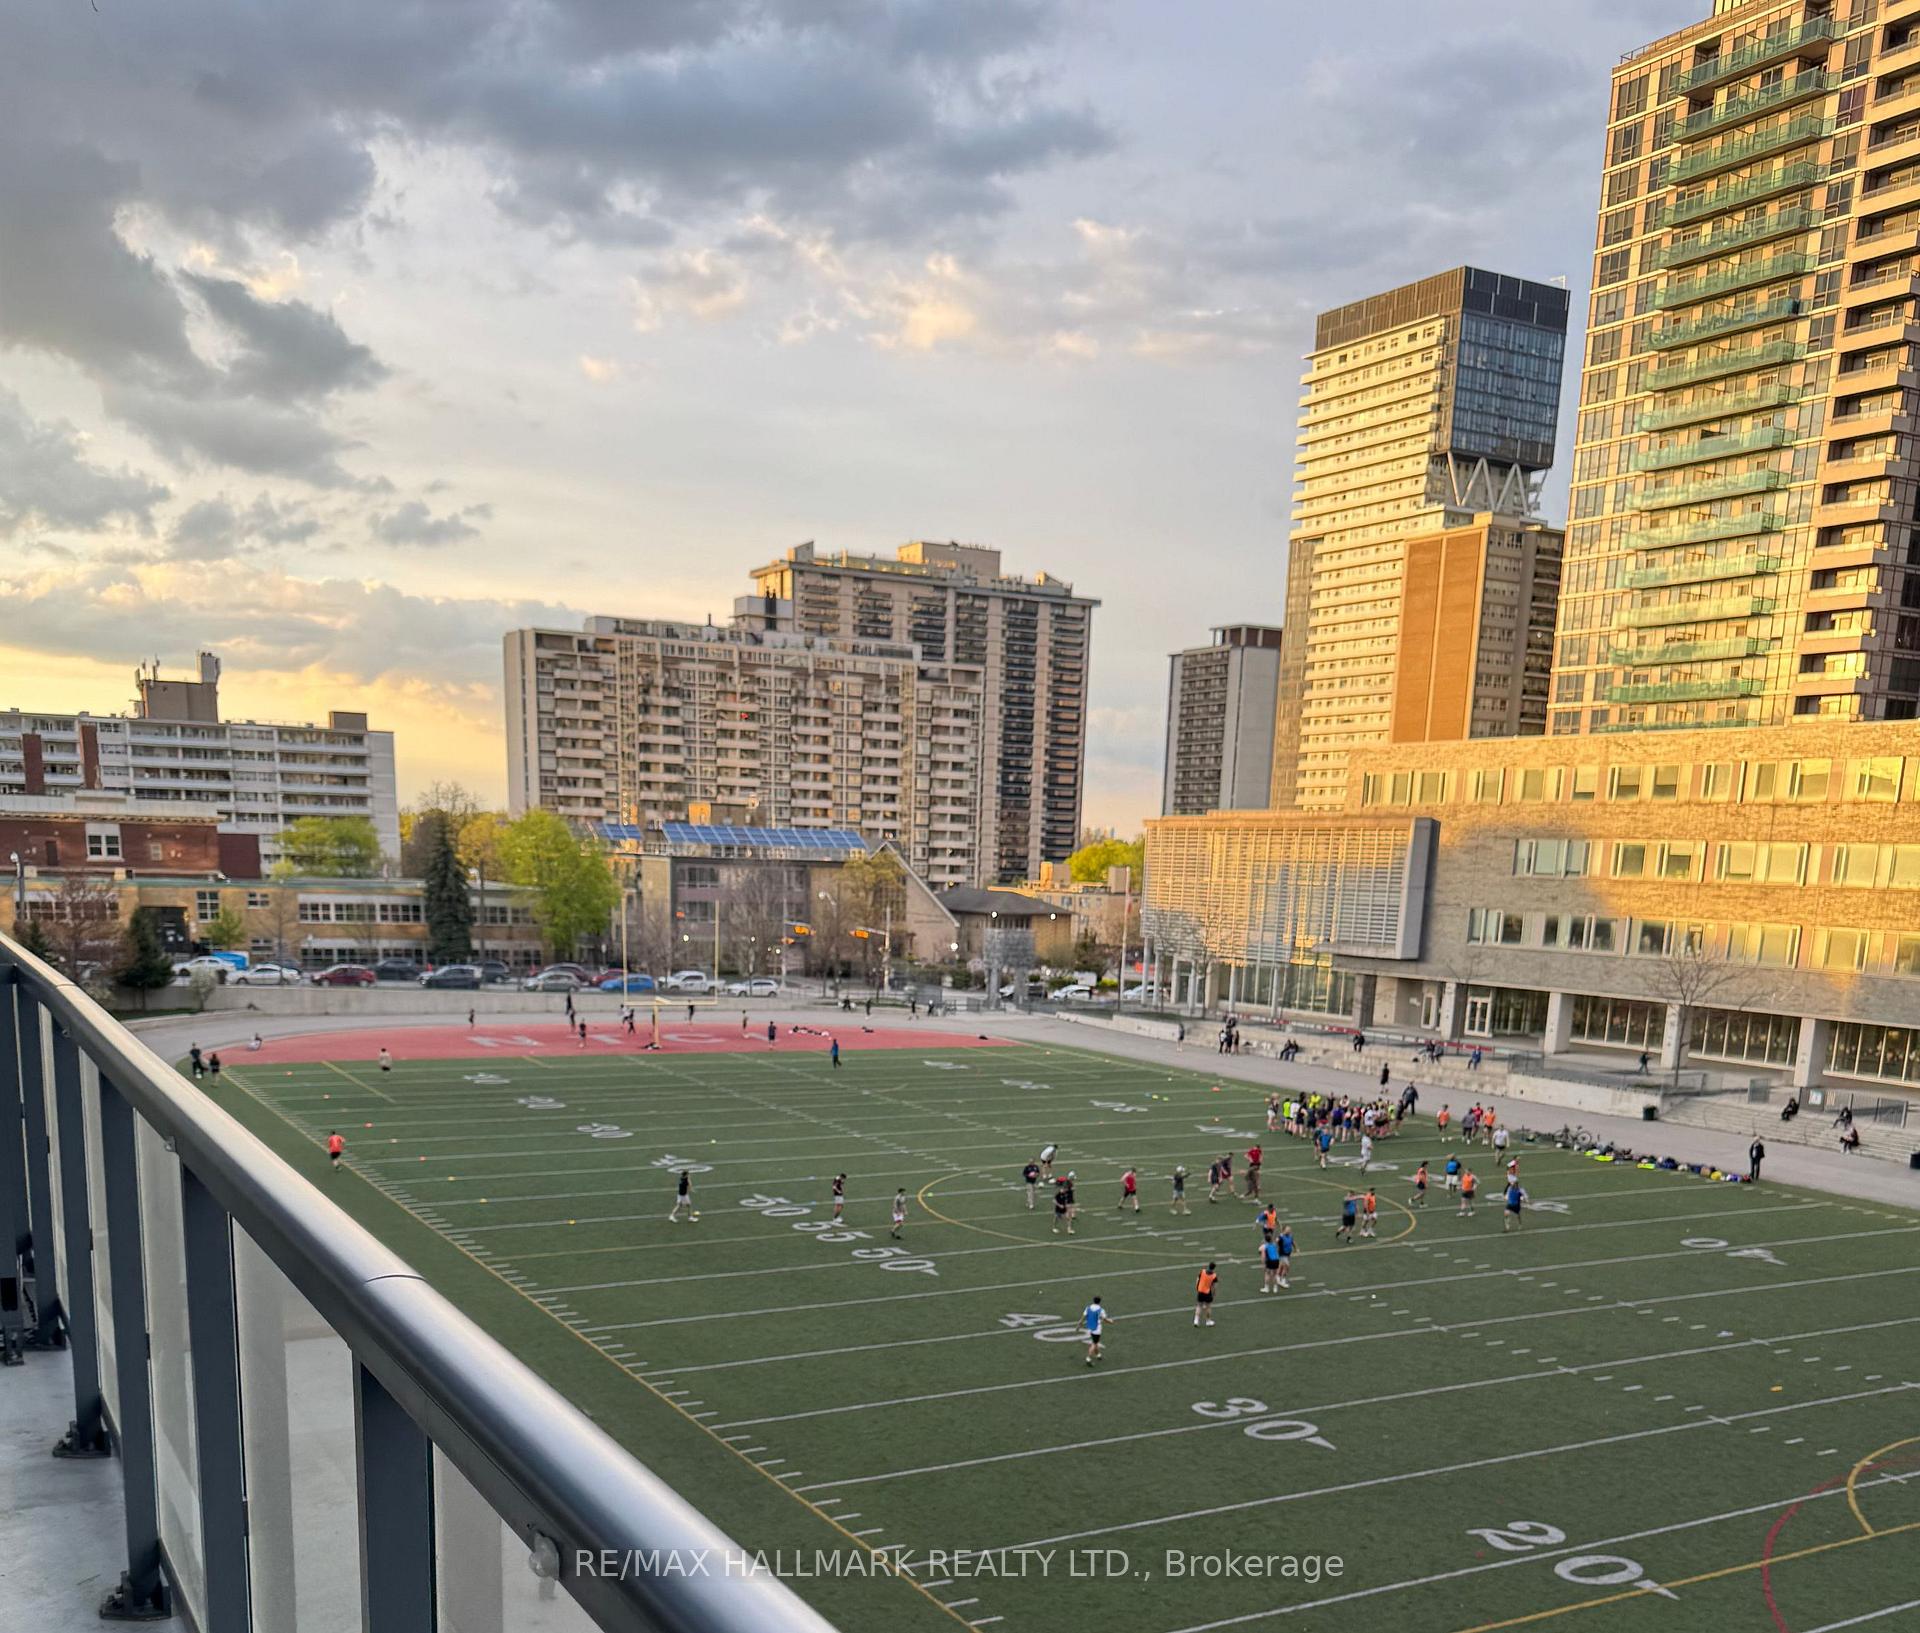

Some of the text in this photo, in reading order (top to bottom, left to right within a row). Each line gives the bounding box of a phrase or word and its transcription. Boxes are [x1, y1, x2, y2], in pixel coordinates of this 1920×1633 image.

[792, 1220, 874, 1243] 55
[851, 1246, 936, 1272] 50
[998, 1313, 1093, 1343] 40
[1191, 1397, 1319, 1441] 30
[1466, 1520, 1645, 1586] 20
